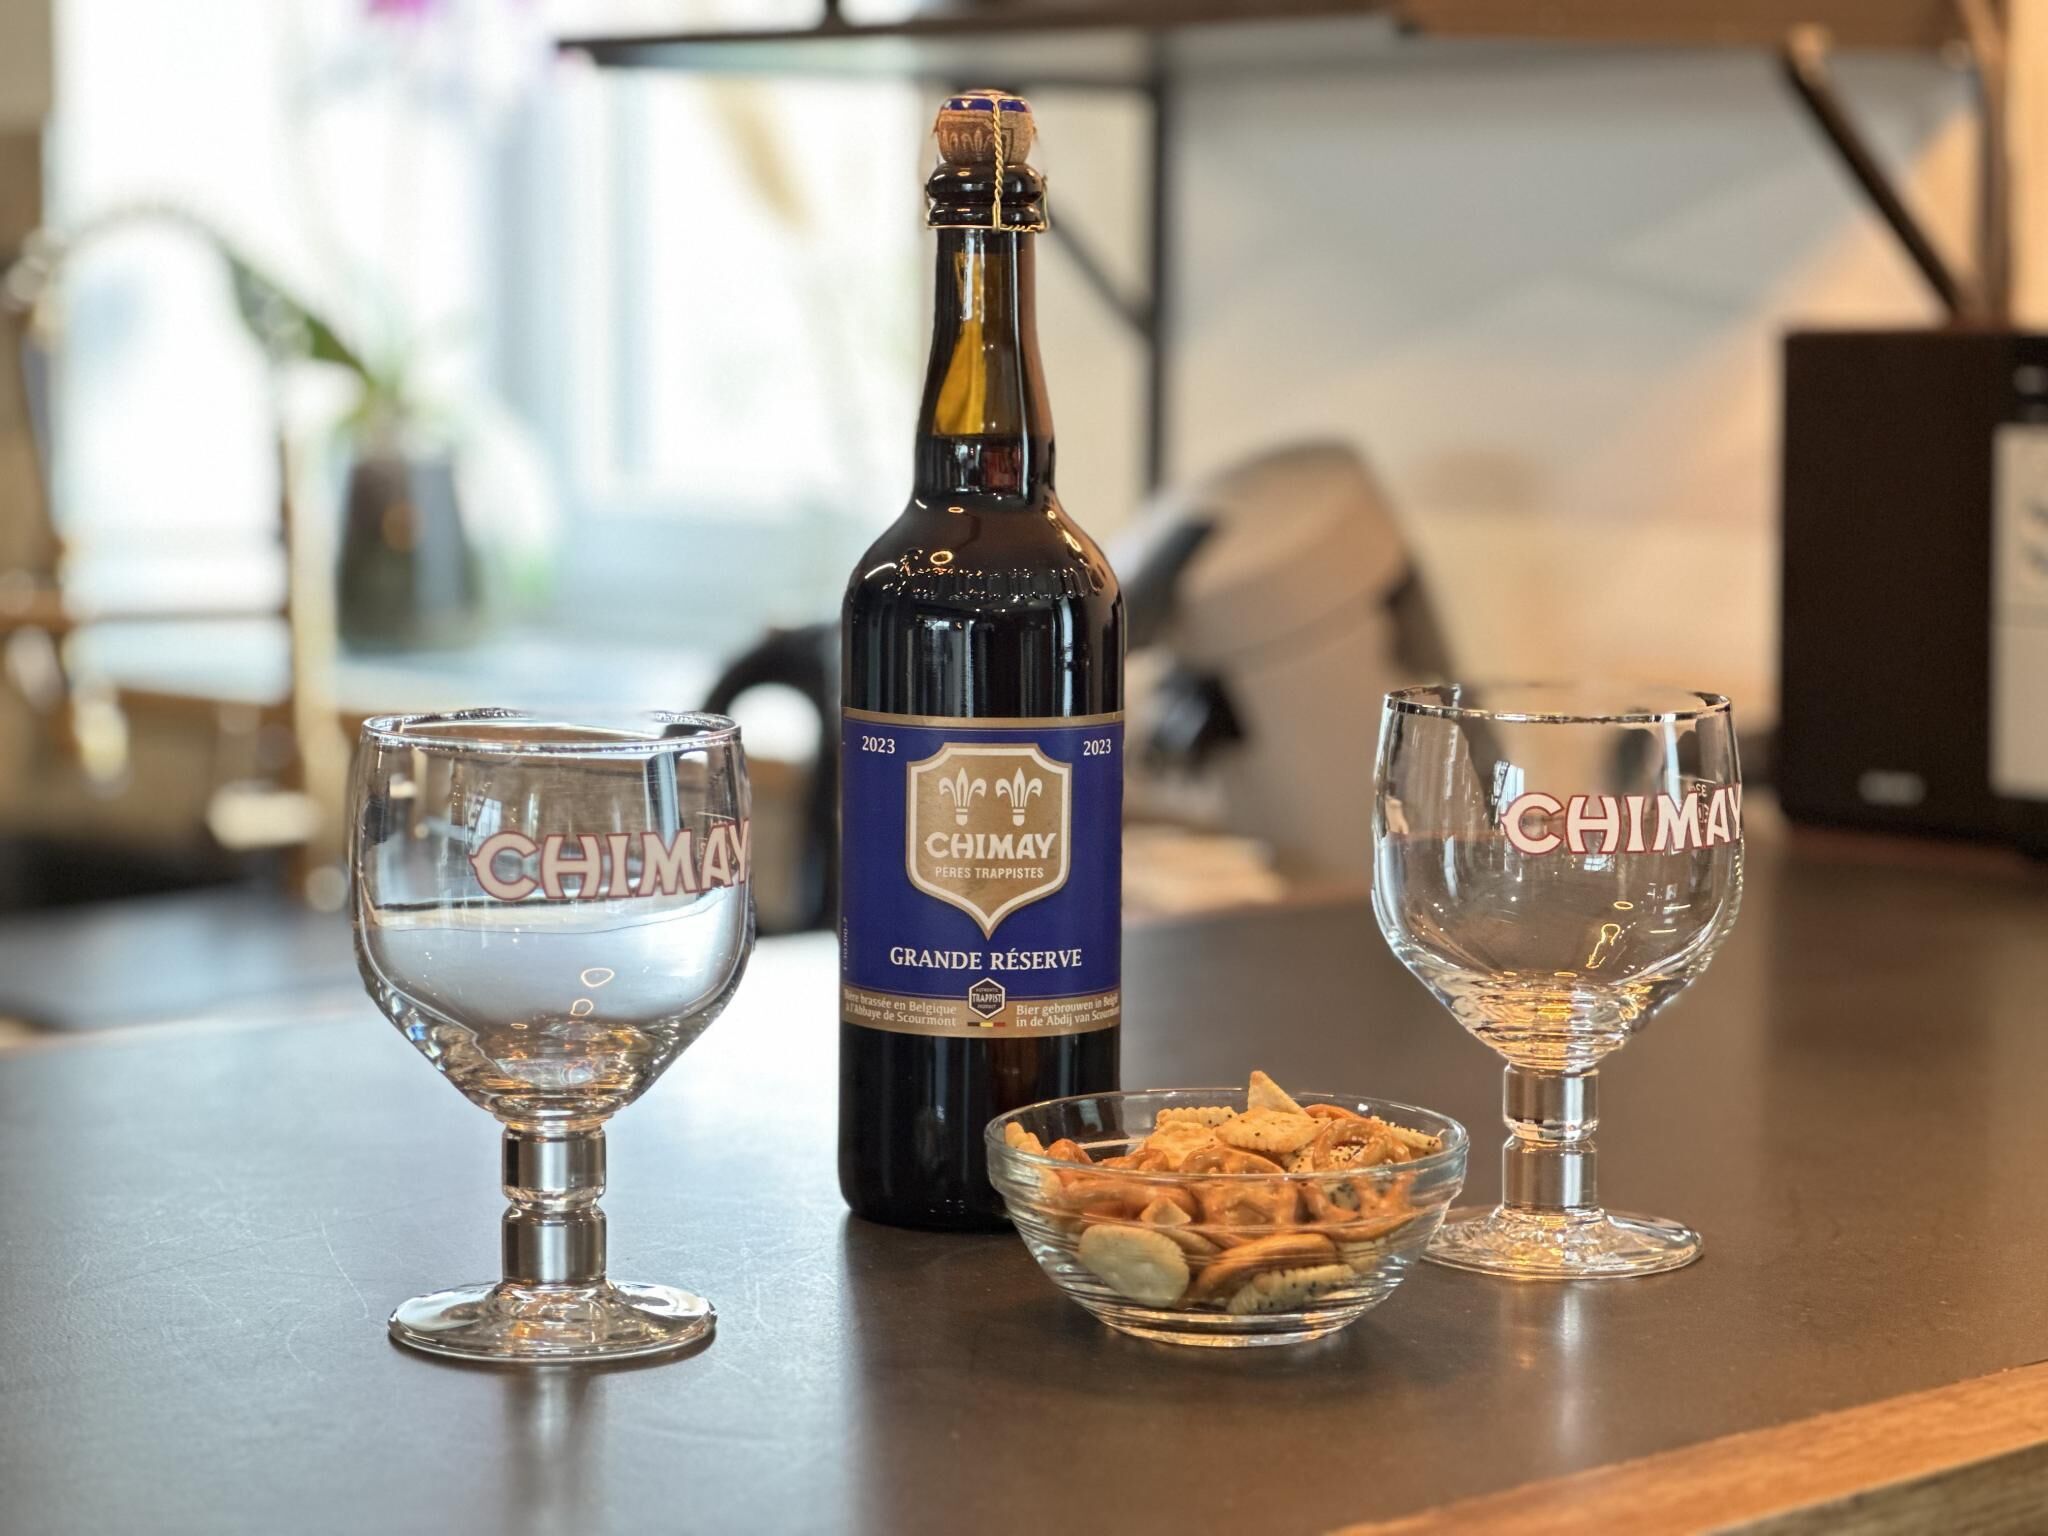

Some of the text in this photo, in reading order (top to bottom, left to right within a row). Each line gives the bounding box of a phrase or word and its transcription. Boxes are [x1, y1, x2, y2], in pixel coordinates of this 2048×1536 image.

[861, 735, 896, 754] 2023
[1083, 738, 1112, 756] 2023
[1500, 783, 1742, 855] CHIMAY
[924, 831, 1057, 860] CHIMAY
[469, 817, 750, 901] CHIMAY
[975, 867, 1044, 879] TRAPPISTES
[890, 946, 1082, 971] GRANDE RÉSERVE
[860, 993, 892, 1009] brassée
[894, 1001, 906, 1011] en
[909, 1001, 957, 1016] Belgique
[972, 993, 1002, 1003] TRAPPIST
[1016, 1005, 1040, 1016] Bier
[1042, 1001, 1094, 1017] gebrouwen
[1095, 998, 1102, 1009] in
[883, 1010, 895, 1021] de
[897, 1012, 956, 1026] Scourmont
[1016, 1017, 1028, 1027] in
[1030, 1015, 1044, 1026] de
[1046, 1013, 1073, 1027] Abdij
[1075, 1013, 1091, 1023] van
